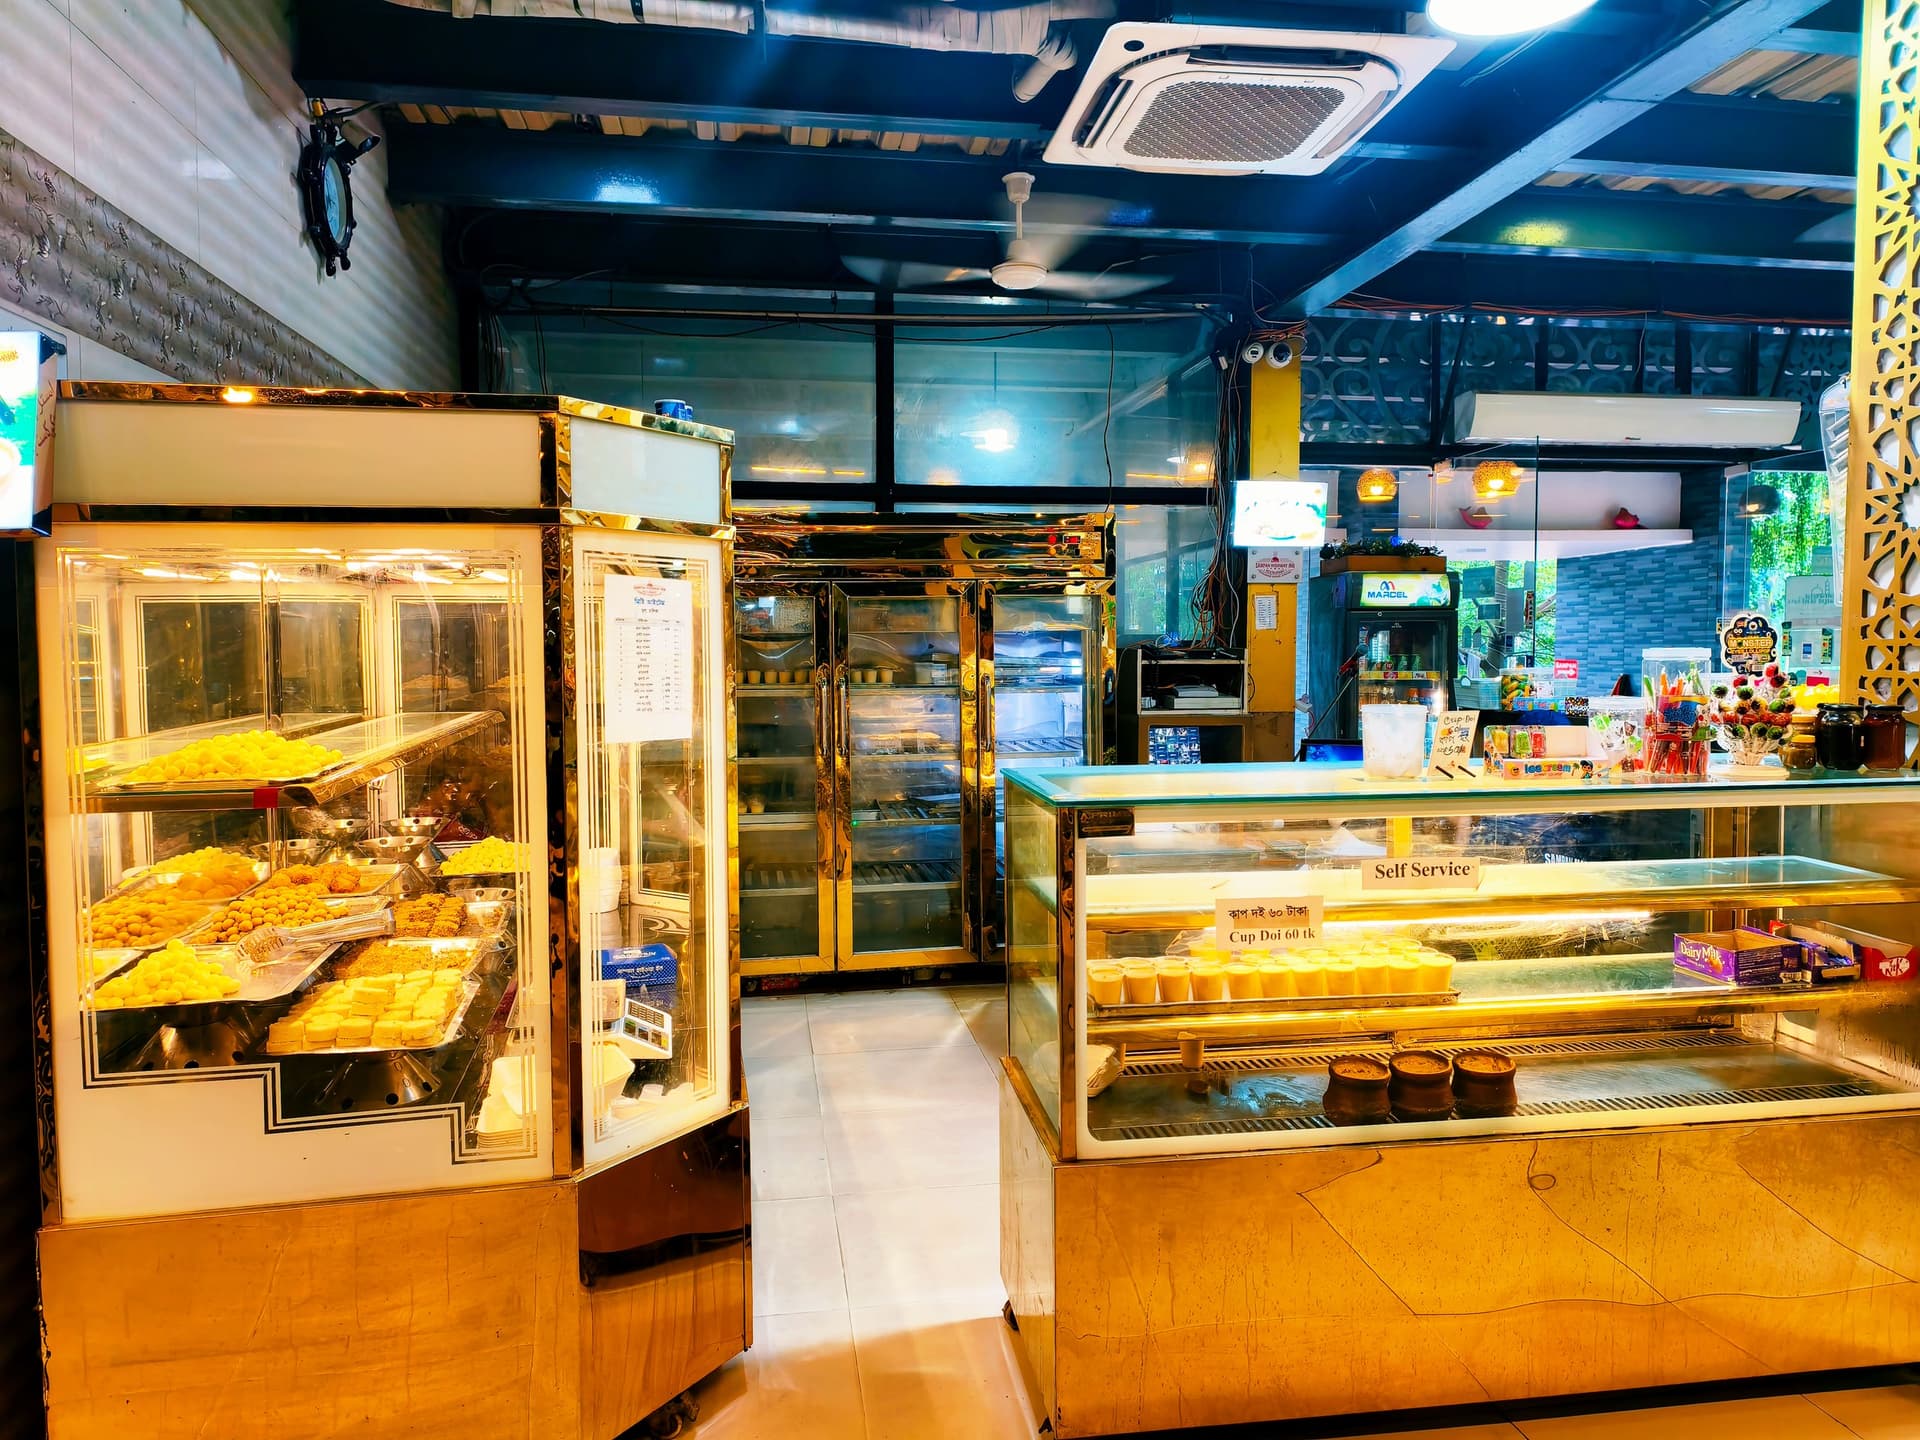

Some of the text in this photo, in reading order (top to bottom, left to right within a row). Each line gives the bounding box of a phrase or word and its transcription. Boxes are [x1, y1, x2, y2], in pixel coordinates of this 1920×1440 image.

[1367, 591, 1408, 599] MARCEL
[1375, 861, 1471, 880] Self Service
[1228, 904, 1308, 920] কাপ দই ৬০ টাকা
[1229, 927, 1316, 945] Cup Doi 60 tk
[1680, 941, 1721, 961] Dairy Milk
